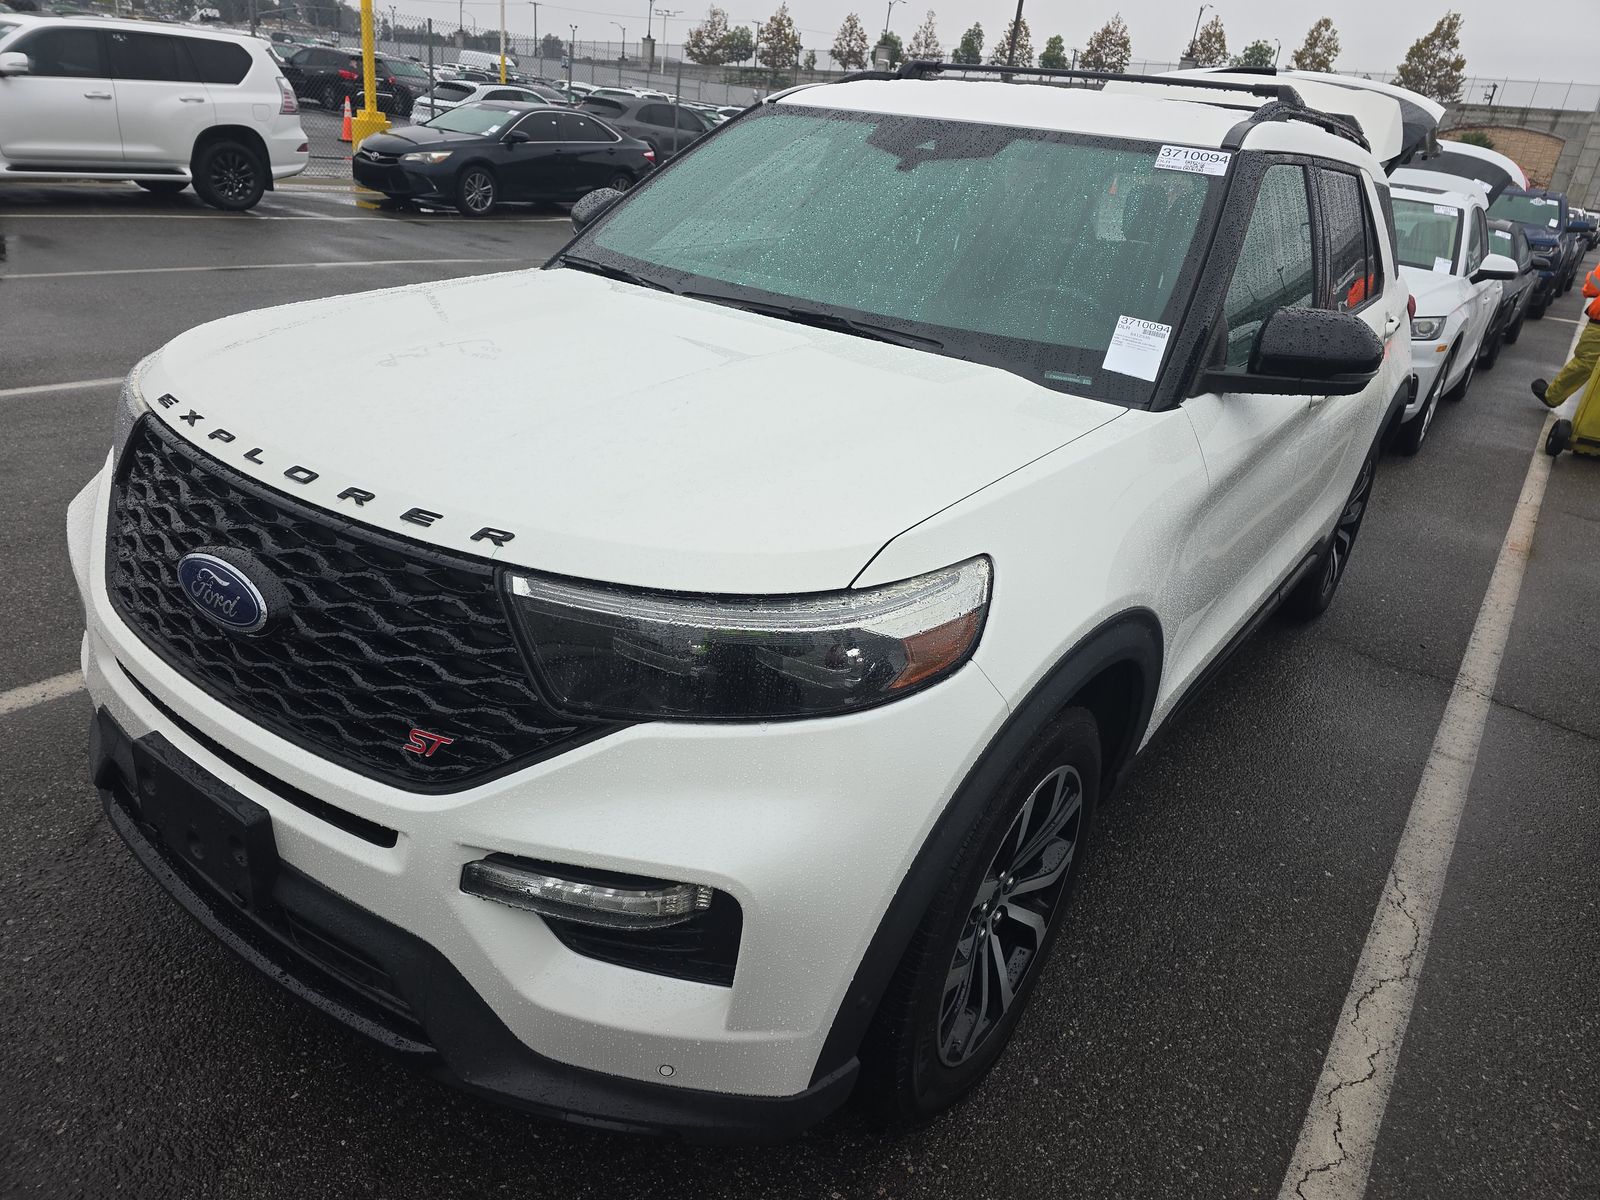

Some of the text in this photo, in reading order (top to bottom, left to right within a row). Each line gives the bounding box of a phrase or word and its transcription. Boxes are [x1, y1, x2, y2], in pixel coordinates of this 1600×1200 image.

[1161, 147, 1229, 164] 3710094
[1120, 316, 1170, 333] 3710094
[157, 393, 516, 547] EXPLORER
[191, 568, 241, 618] Ford
[402, 728, 455, 757] ST
